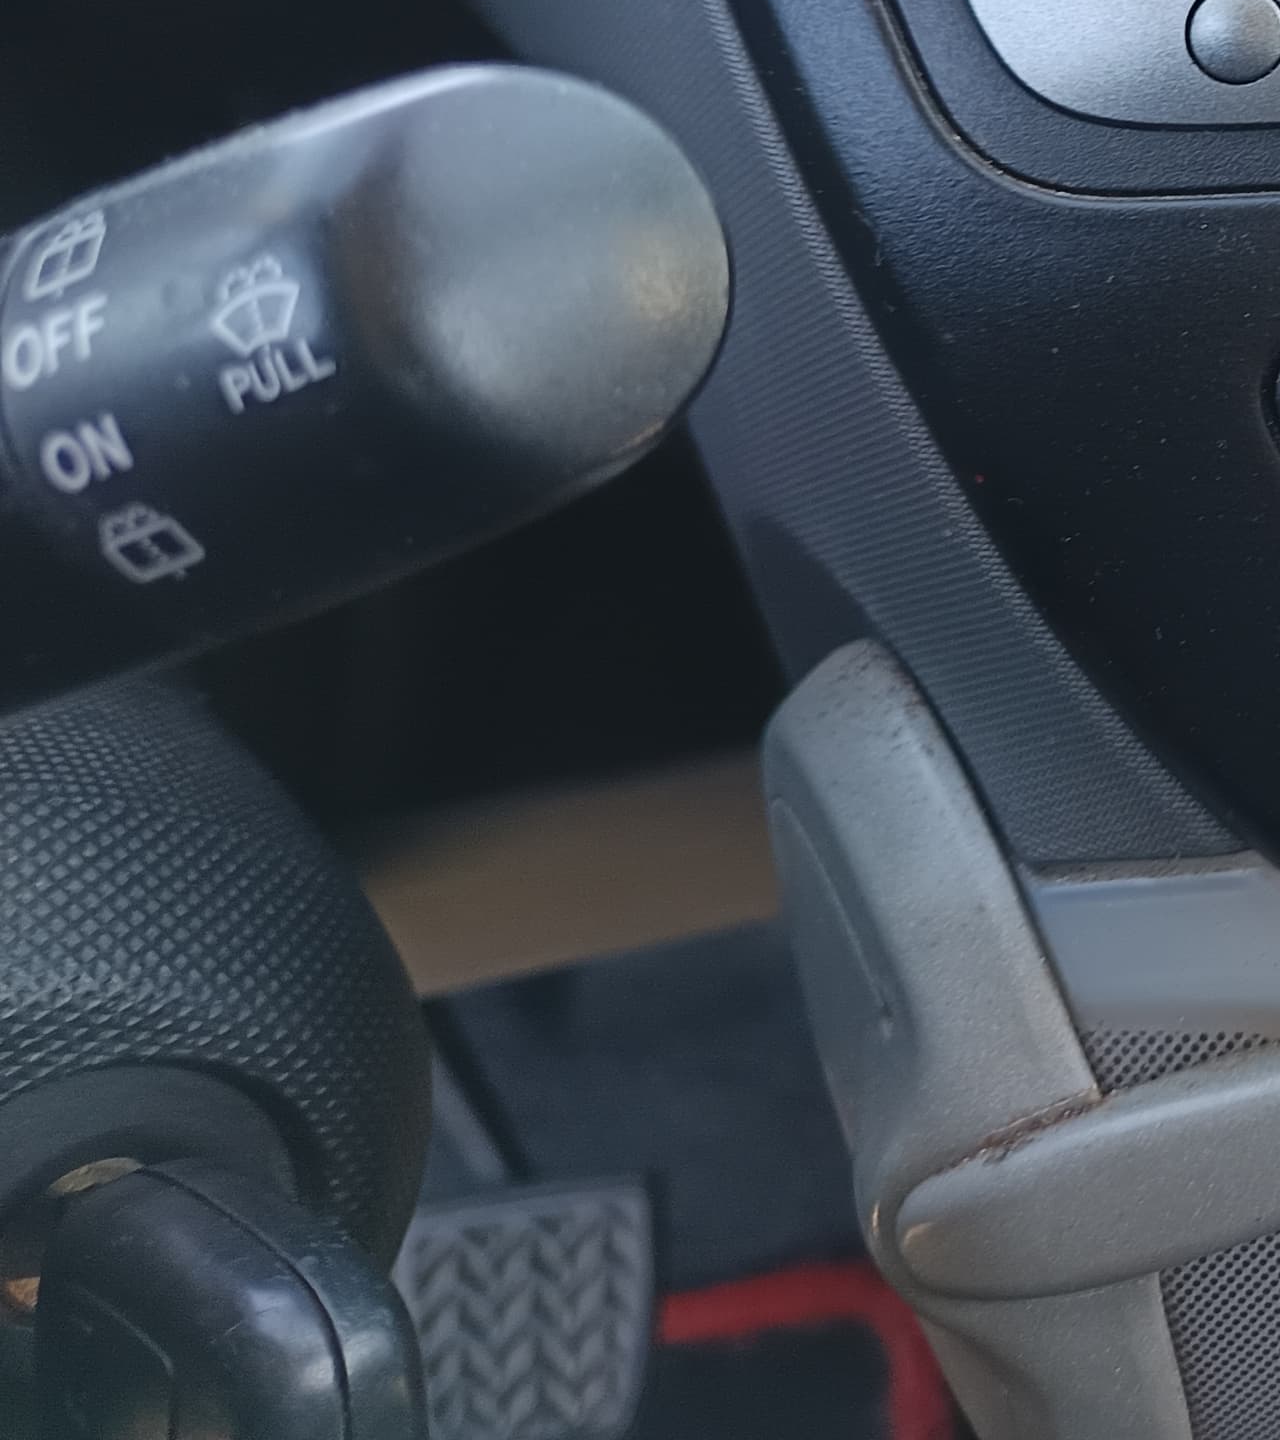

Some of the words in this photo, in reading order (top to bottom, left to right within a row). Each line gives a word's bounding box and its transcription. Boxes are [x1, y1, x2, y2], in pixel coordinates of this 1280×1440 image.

[2, 292, 109, 390] OFF
[218, 335, 338, 416] PULL
[39, 412, 135, 495] ON
